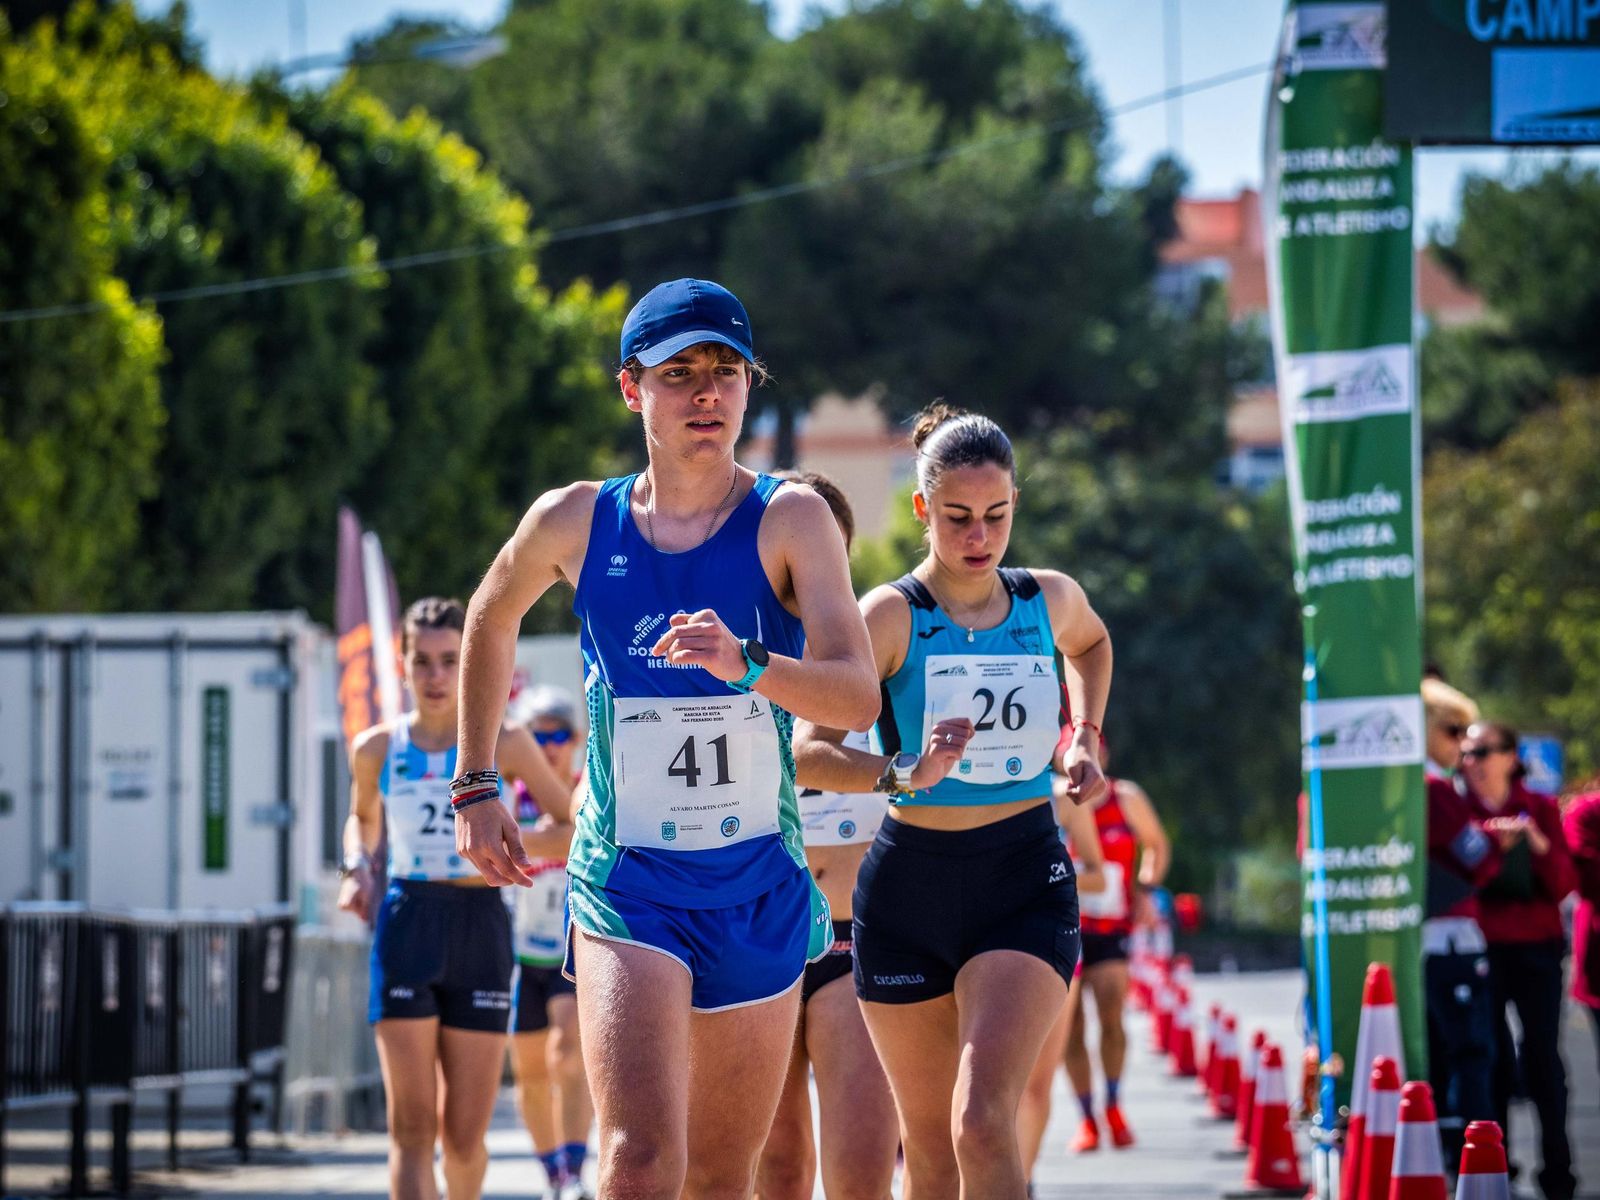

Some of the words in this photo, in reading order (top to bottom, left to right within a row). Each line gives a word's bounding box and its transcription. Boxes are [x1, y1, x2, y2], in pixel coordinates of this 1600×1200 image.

[632, 613, 665, 646] ATLETISMO
[634, 615, 652, 632] CLUB
[972, 686, 1027, 731] 26
[668, 733, 737, 788] 41
[717, 800, 740, 809] COSANO
